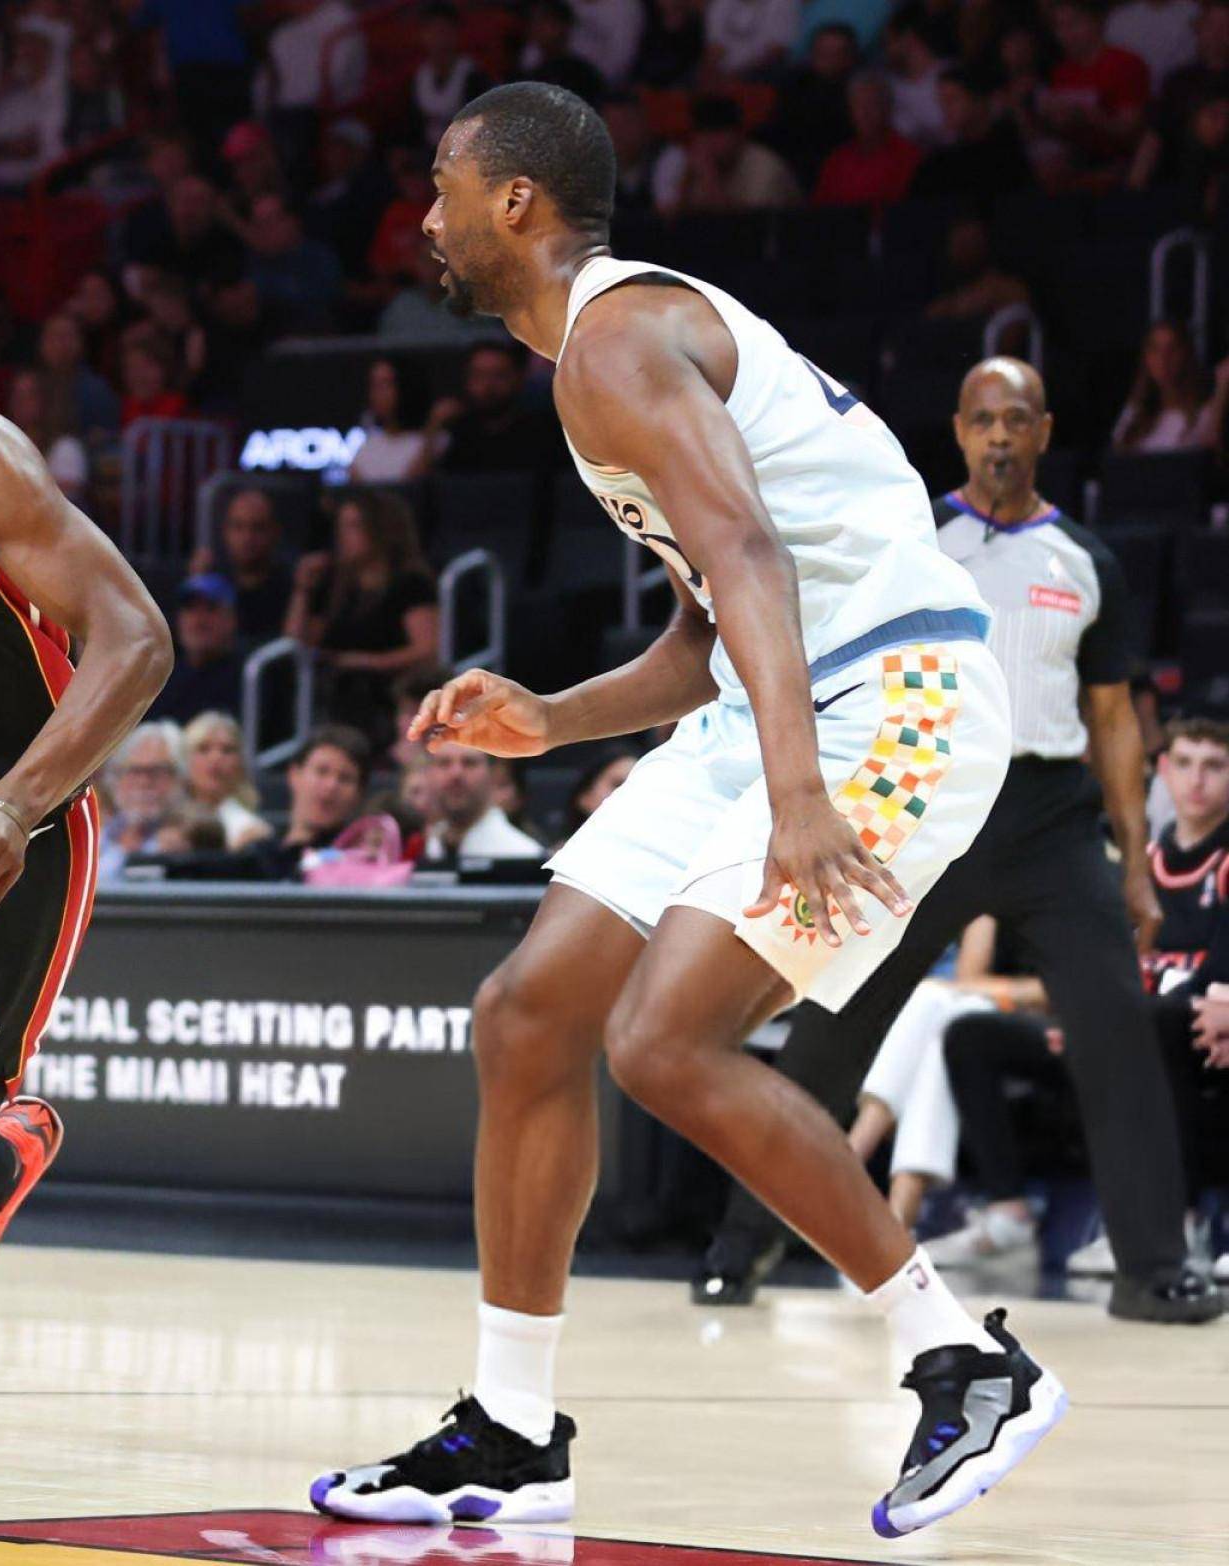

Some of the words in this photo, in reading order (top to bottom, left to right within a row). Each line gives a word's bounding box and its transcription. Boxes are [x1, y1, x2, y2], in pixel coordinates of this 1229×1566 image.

[146, 999, 352, 1048] SCENTING
[26, 1053, 98, 1101] THE
[105, 1056, 229, 1106] MIAMI
[239, 1061, 348, 1111] HEAT
